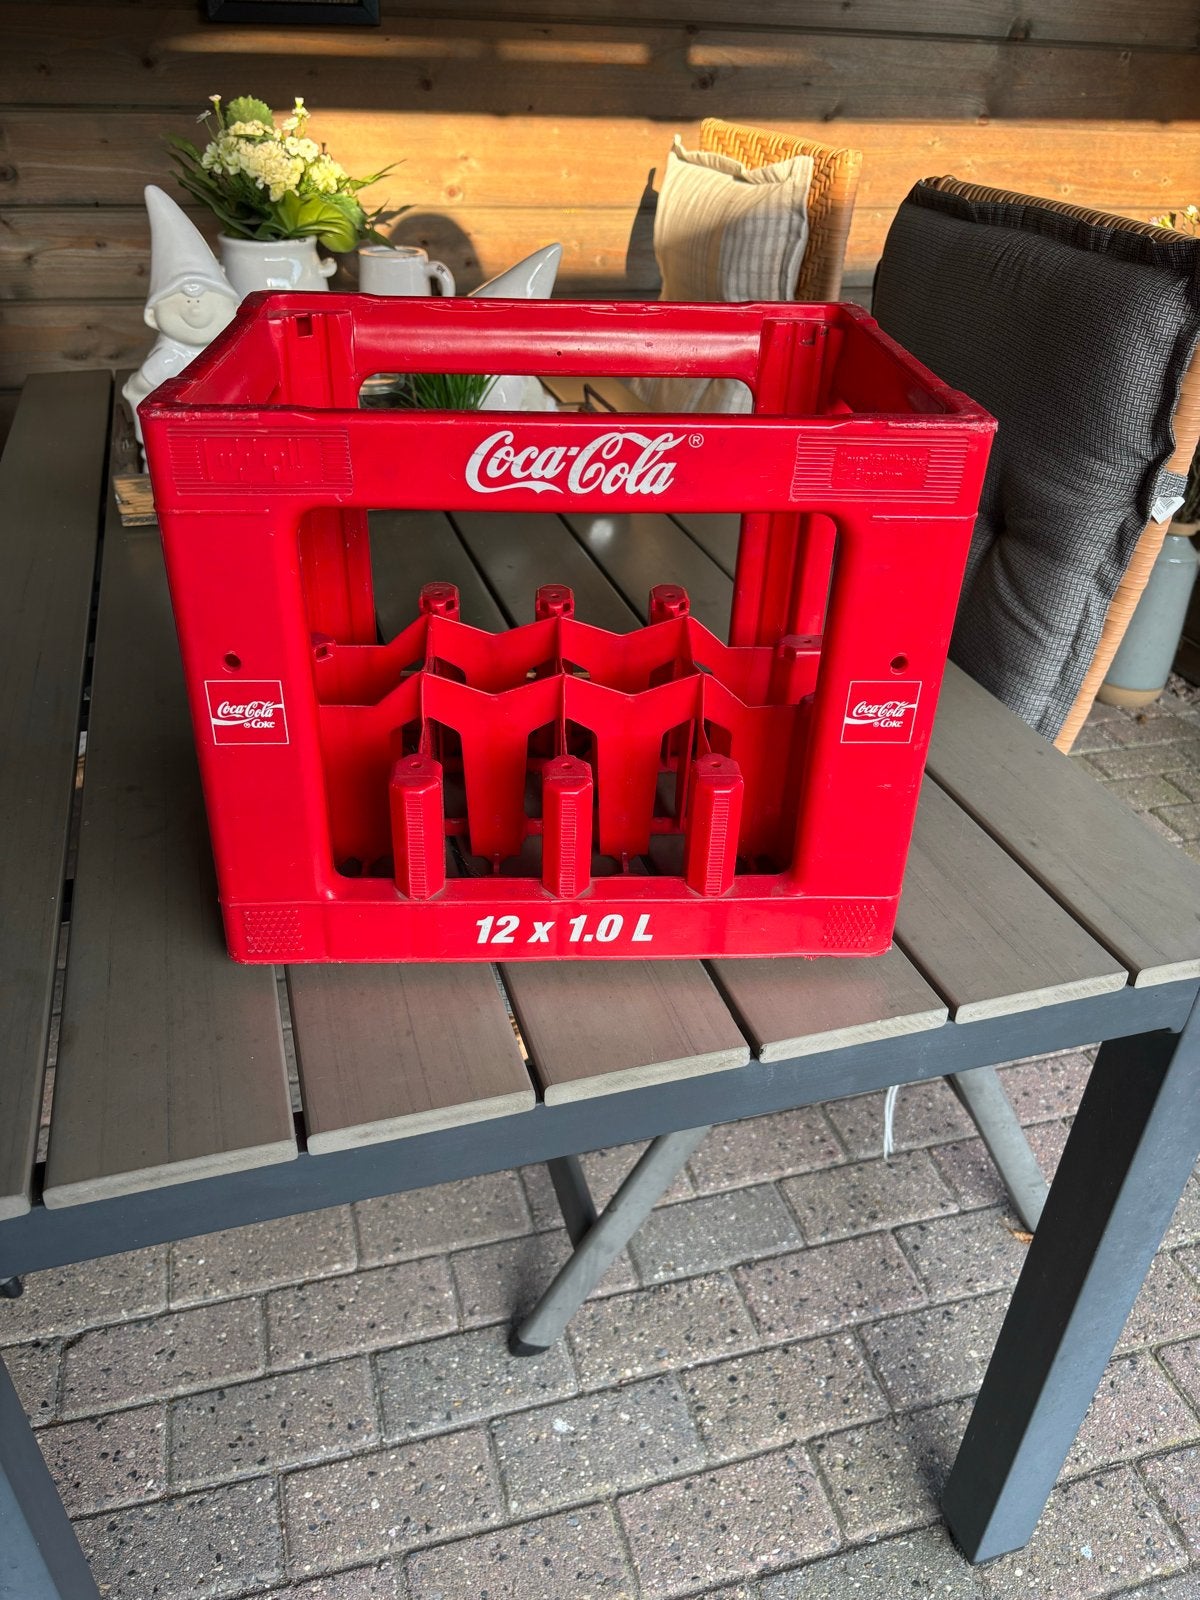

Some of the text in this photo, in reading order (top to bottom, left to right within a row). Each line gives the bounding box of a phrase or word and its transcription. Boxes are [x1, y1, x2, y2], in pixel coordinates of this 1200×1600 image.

[465, 429, 687, 495] Coca-Cola
[217, 700, 275, 718] Coca-Cola
[852, 700, 909, 718] Coca-Cola
[476, 913, 654, 944] 12 x 1.0 L
